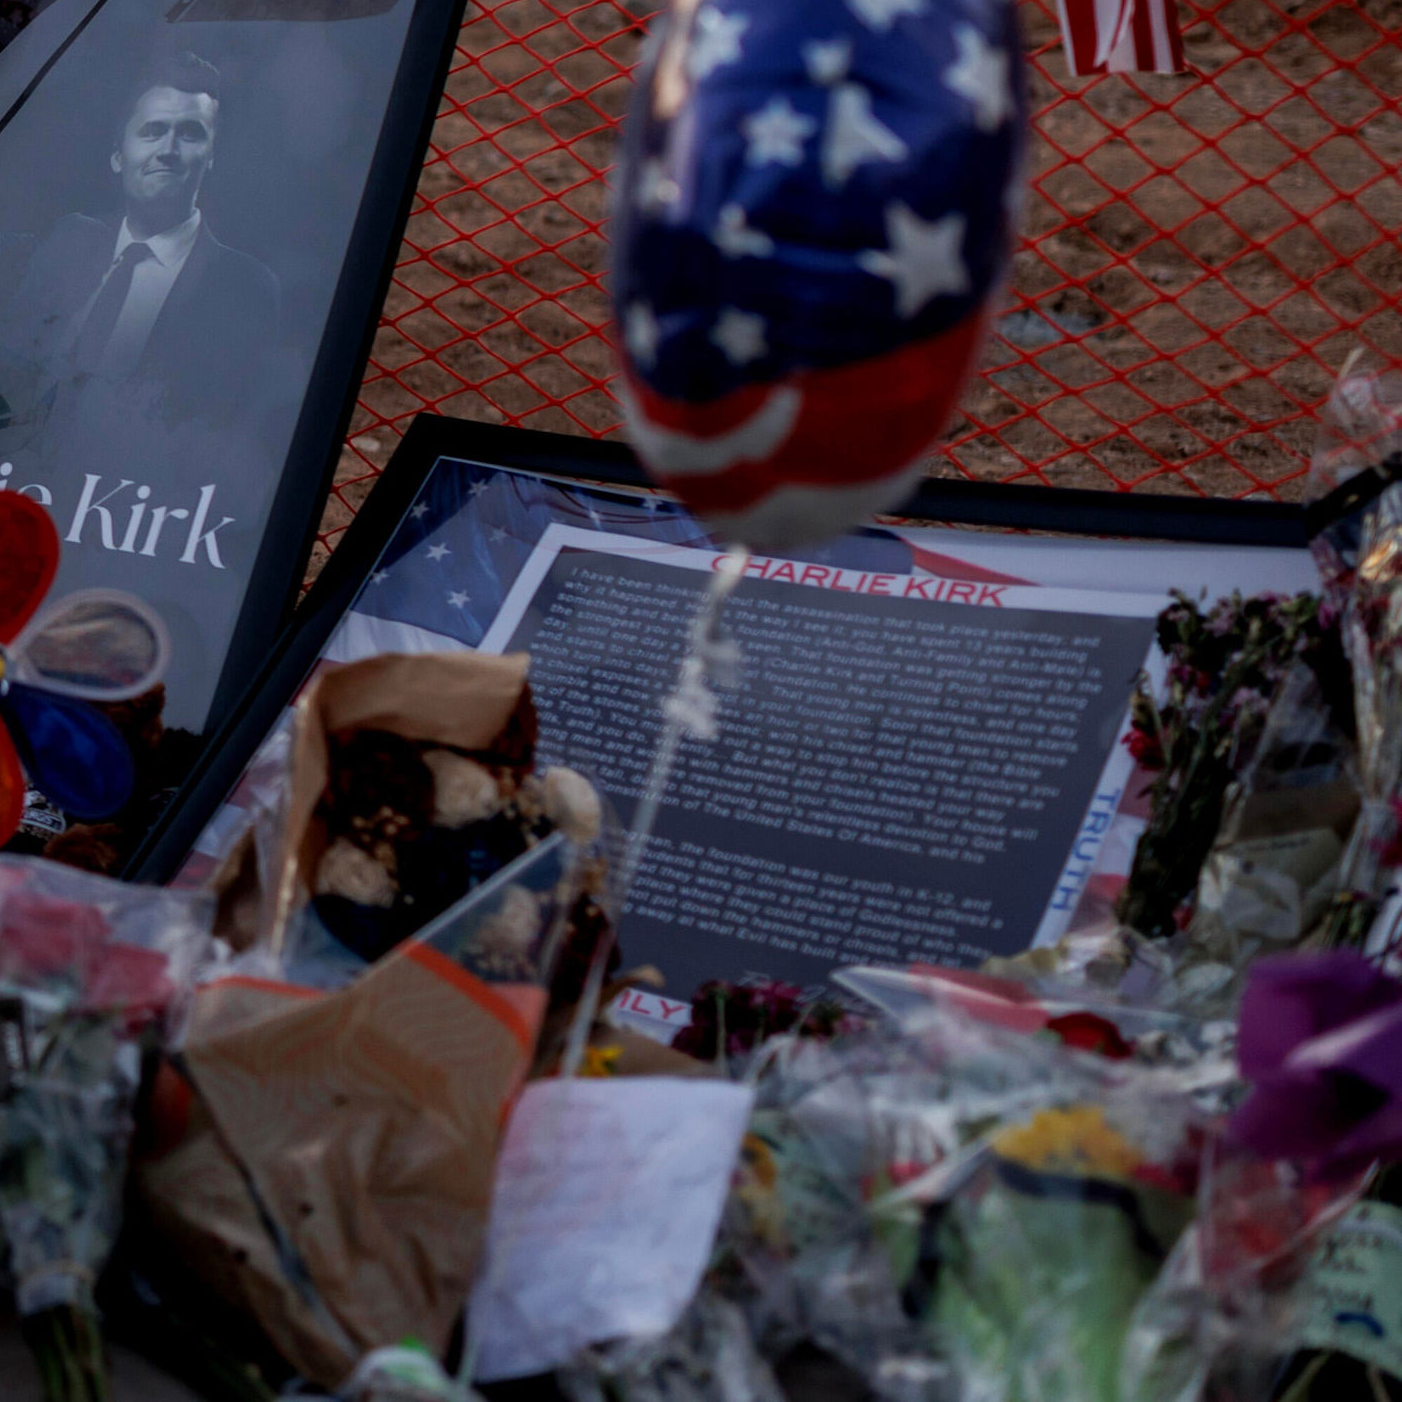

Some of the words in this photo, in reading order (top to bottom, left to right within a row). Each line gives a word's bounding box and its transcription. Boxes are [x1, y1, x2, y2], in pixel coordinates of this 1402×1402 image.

[64, 472, 236, 569] Kirk
[579, 570, 614, 583] have
[616, 577, 653, 590] been
[725, 595, 753, 606] out
[755, 600, 780, 610] the
[782, 604, 880, 624] assassination
[913, 620, 946, 631] took
[948, 624, 989, 637] place
[1073, 636, 1101, 645] and
[711, 554, 898, 596] CHARLIE
[903, 576, 1009, 608] KIRK
[569, 735, 601, 747] men
[604, 741, 633, 753] and
[689, 757, 720, 770] with
[721, 763, 790, 783] hammers
[791, 776, 821, 789] and
[687, 771, 753, 791] removed
[754, 784, 791, 798] from
[790, 792, 826, 807] your
[710, 791, 757, 809] young
[701, 802, 732, 816] The
[732, 808, 784, 827] United
[927, 845, 959, 859] and
[1052, 787, 1122, 910] TRUTH
[639, 848, 697, 868] udents
[697, 860, 730, 875] that
[731, 868, 755, 880] for
[817, 887, 861, 904] years
[656, 867, 693, 884] they
[693, 877, 731, 891] were
[732, 883, 777, 902] given
[791, 895, 836, 914] place
[677, 841, 705, 855] the
[705, 847, 787, 872] foundation
[788, 866, 819, 879] was
[960, 897, 992, 911] and
[632, 876, 676, 895] place
[676, 885, 725, 904] where
[724, 896, 762, 914] they
[763, 904, 807, 921] could
[809, 913, 853, 930] stand
[853, 922, 901, 942] proud
[633, 907, 674, 924] away
[694, 919, 734, 935] what
[734, 928, 767, 943] Evil
[768, 935, 798, 949] has
[799, 941, 837, 957] built
[677, 900, 720, 918] down
[721, 910, 749, 924] the
[749, 916, 821, 939] hammers
